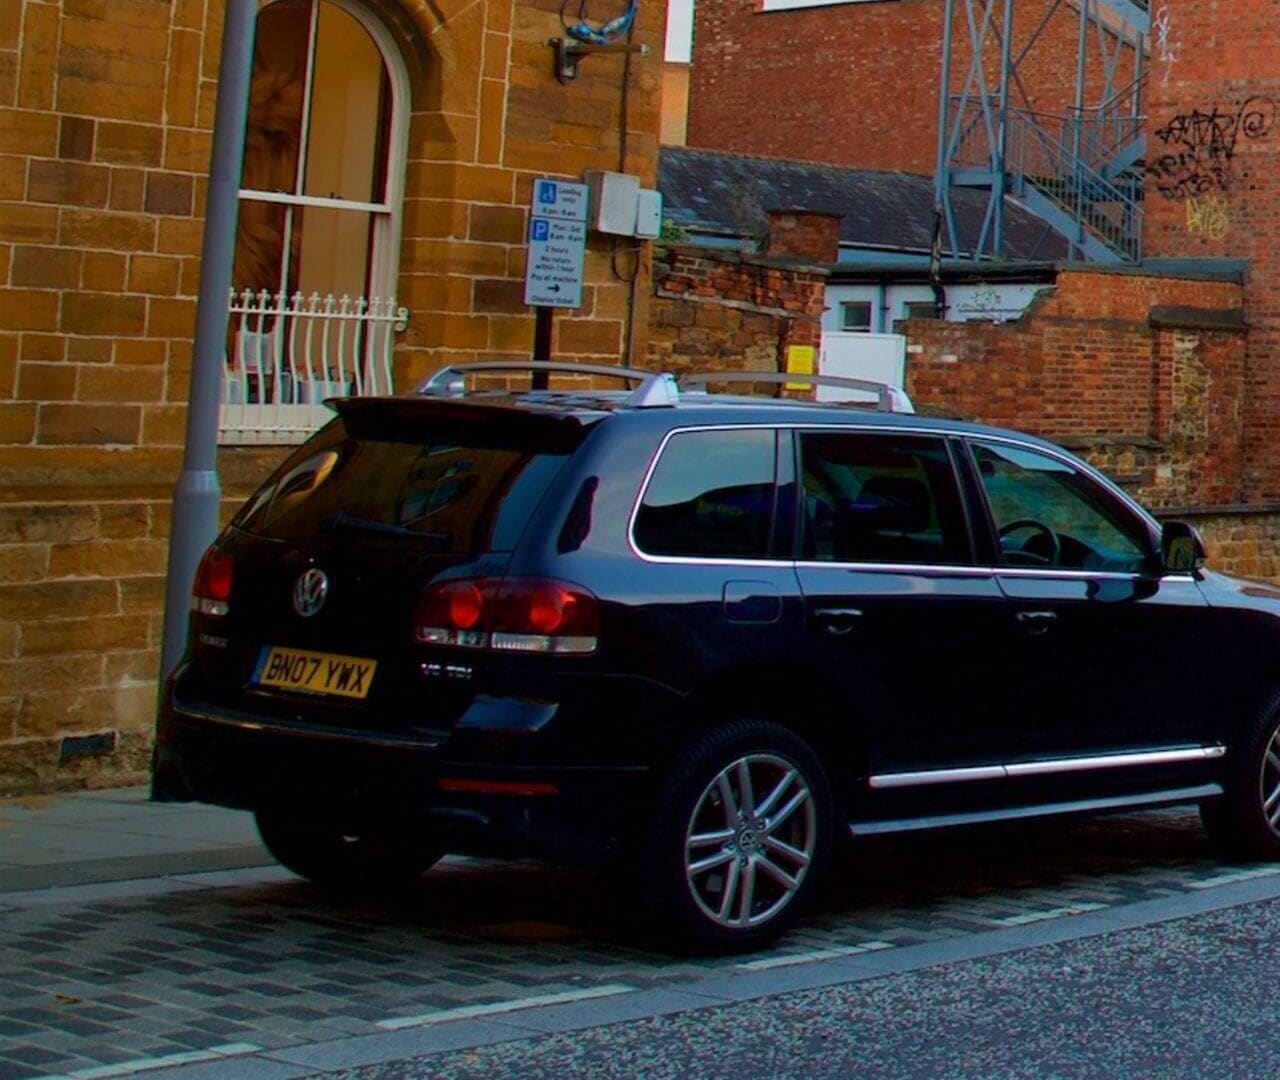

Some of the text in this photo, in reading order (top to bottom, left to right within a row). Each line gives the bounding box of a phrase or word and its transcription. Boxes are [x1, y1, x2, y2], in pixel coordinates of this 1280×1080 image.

[558, 187, 582, 197] Loading
[266, 653, 370, 693] BN07 YWX
